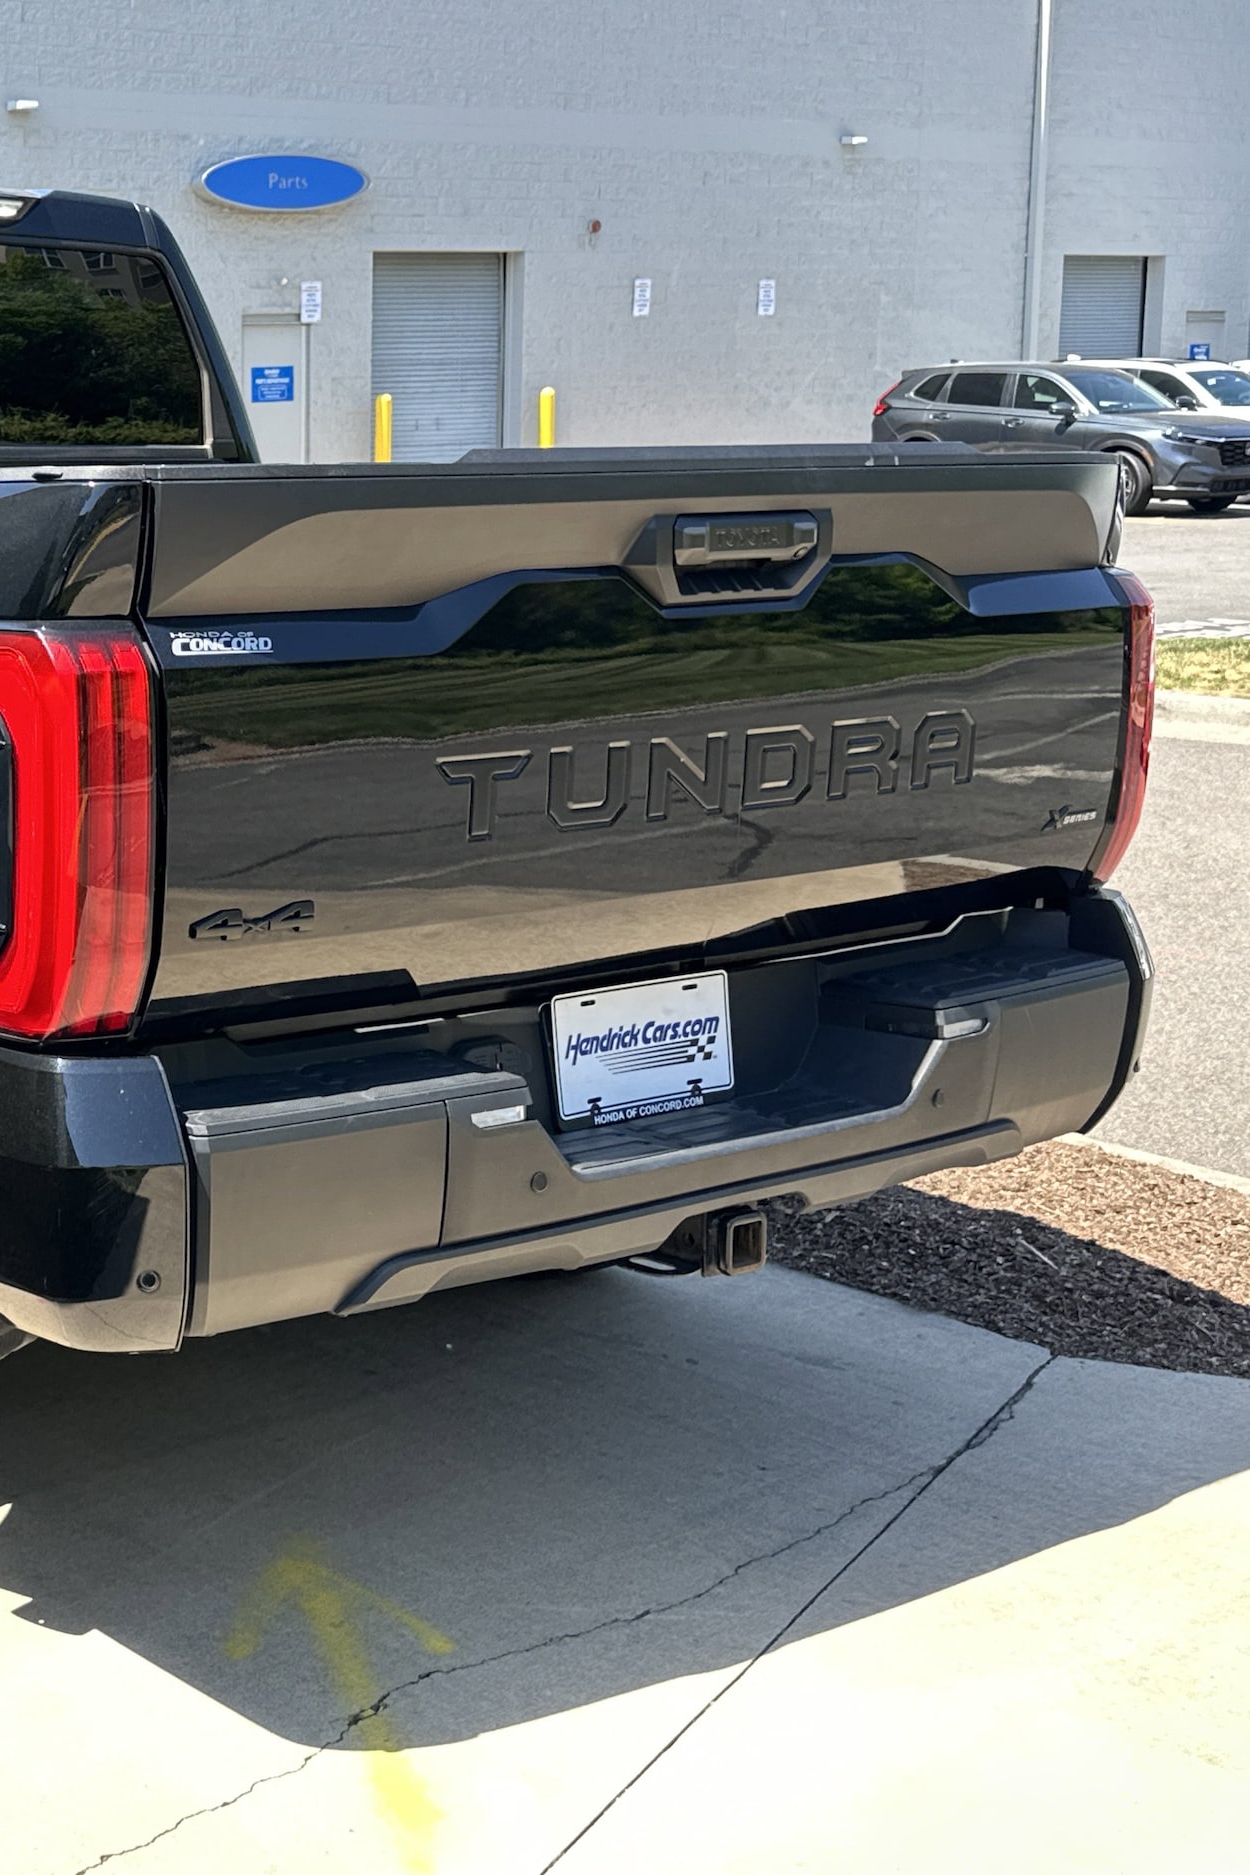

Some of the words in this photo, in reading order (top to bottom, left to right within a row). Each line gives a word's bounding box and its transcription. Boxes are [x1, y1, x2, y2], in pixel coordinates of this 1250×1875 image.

[268, 172, 308, 189] Parts
[716, 526, 780, 547] TOYOTA
[171, 637, 274, 656] CONCORD
[435, 708, 976, 842] TUNDRA
[565, 1023, 641, 1066] Hendrick
[594, 1110, 624, 1125] HONDA
[627, 1108, 637, 1119] OF
[639, 1095, 704, 1116] CONCORD.COM
